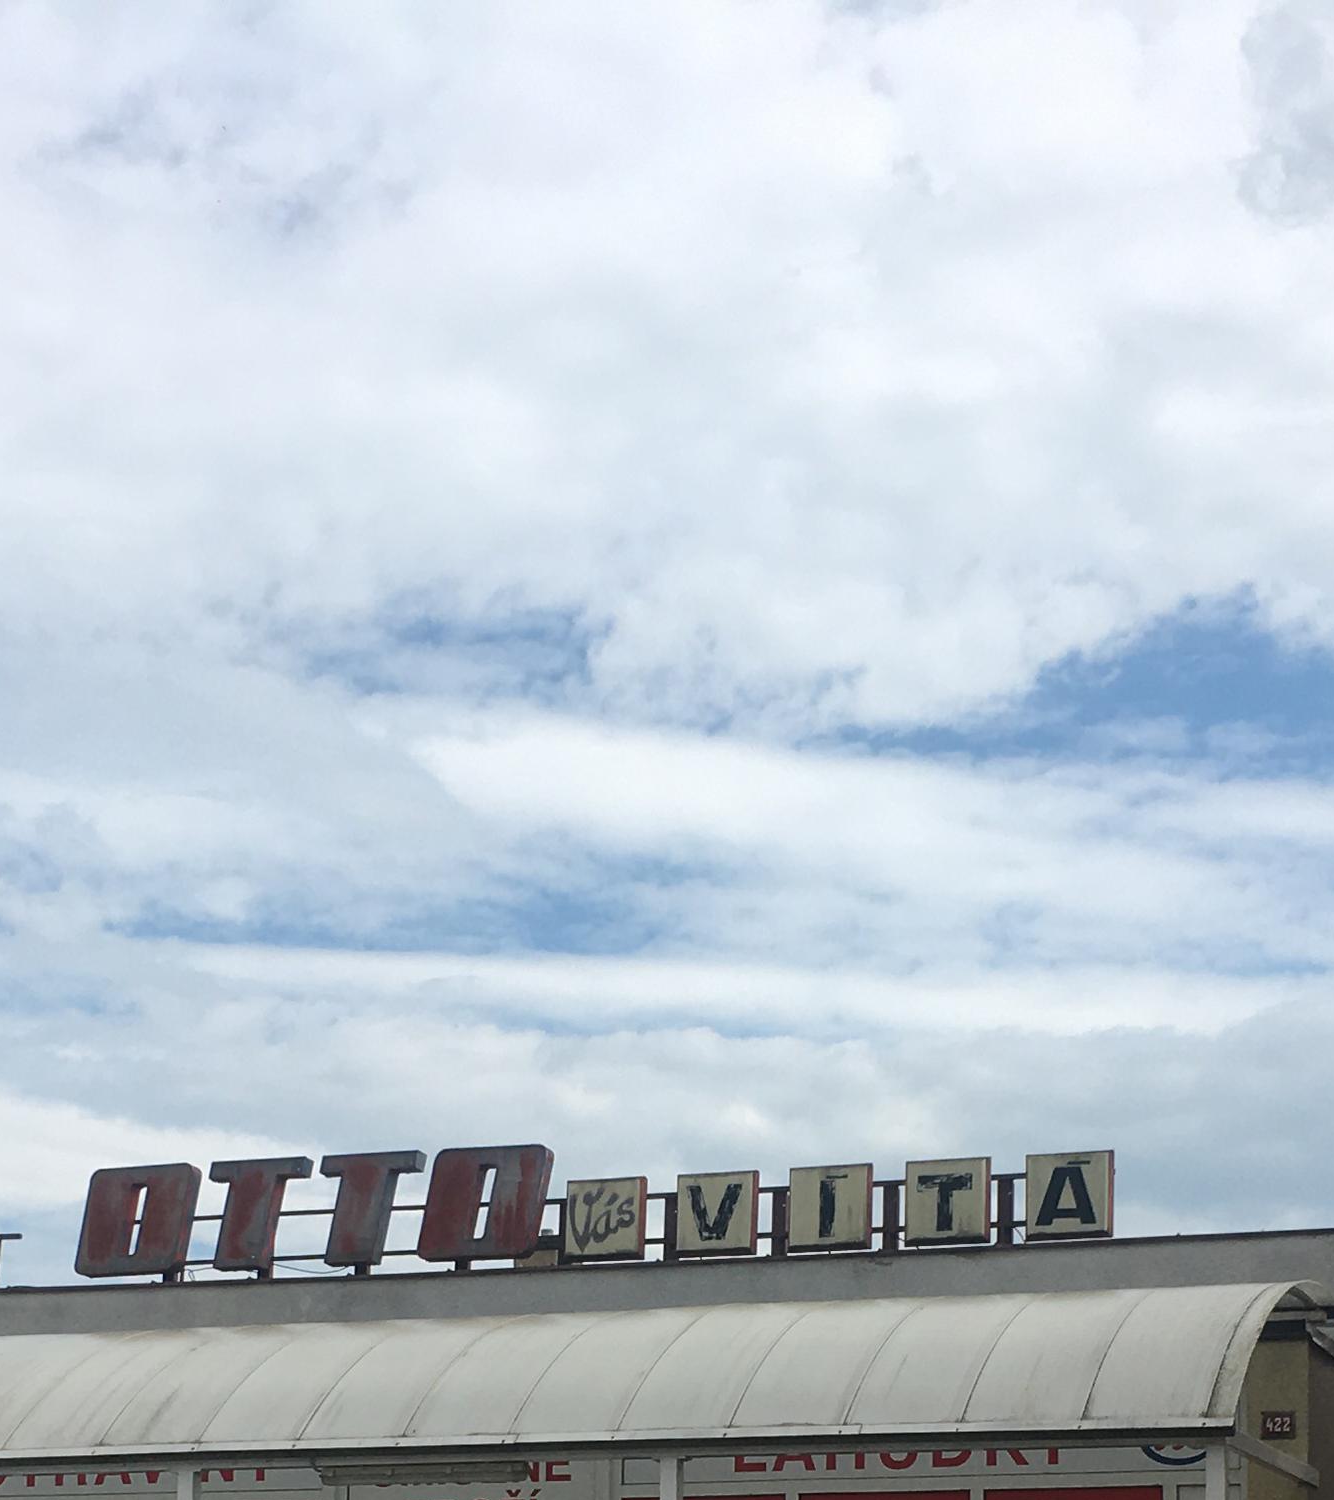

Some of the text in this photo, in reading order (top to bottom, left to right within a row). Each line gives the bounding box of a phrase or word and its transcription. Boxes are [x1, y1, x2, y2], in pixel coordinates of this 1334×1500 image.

[74, 1144, 554, 1278] OTTO
[568, 1187, 636, 1254] Vás
[1266, 1417, 1292, 1432] 422
